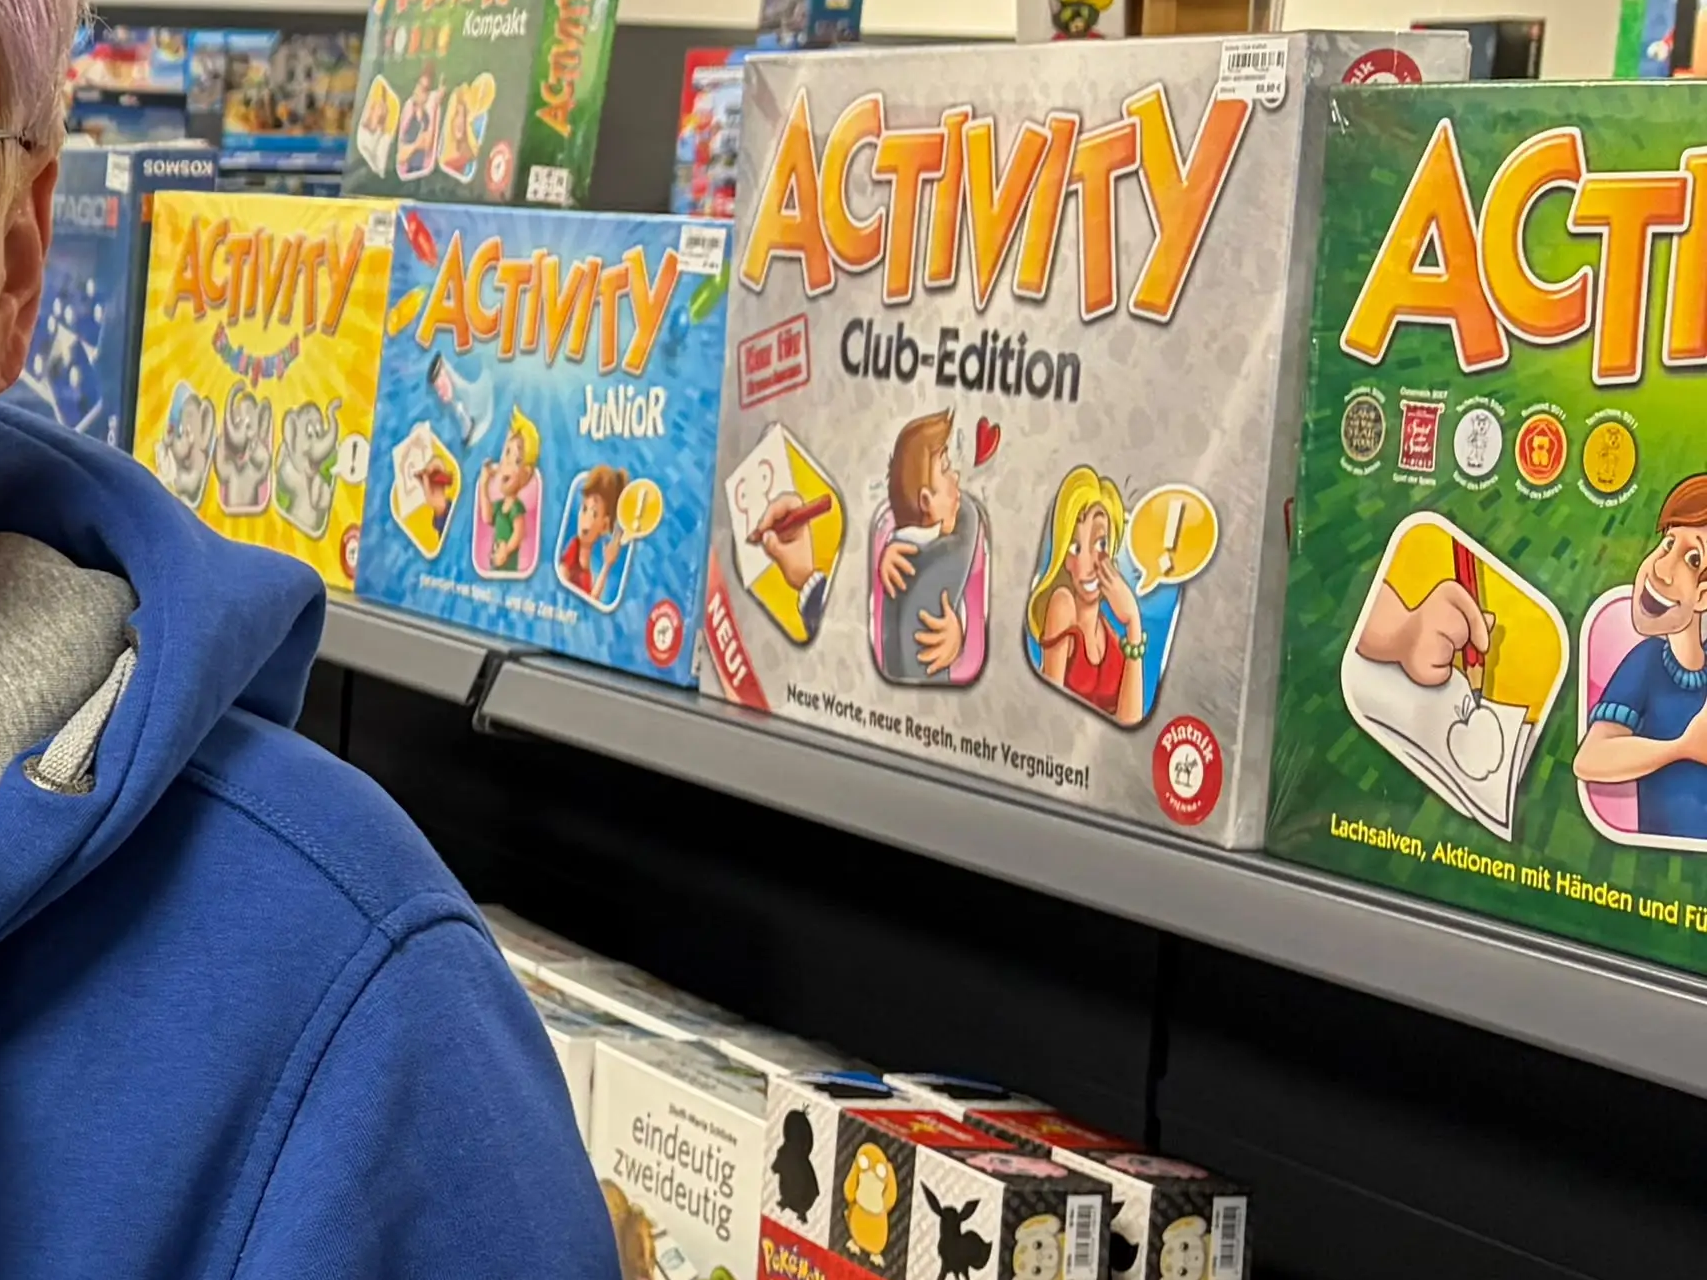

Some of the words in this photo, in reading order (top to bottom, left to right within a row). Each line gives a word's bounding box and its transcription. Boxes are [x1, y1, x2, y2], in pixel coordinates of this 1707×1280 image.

[462, 7, 528, 41] Kompakt
[142, 157, 214, 179] KOSMOS
[739, 83, 1252, 326] ACTIVITY
[163, 213, 366, 337] ACTIVITY
[416, 229, 680, 375] ACTIVITY
[839, 316, 1082, 403] Club-Edition
[707, 590, 748, 687] NEU!
[787, 683, 820, 711] Neue
[821, 693, 868, 724] Worte,
[869, 709, 902, 735] neue
[905, 716, 958, 753] Regeln,
[960, 735, 998, 763] mehr
[1000, 744, 1090, 790] Vergnügen!
[1161, 723, 1214, 765] Piatnik
[1330, 812, 1427, 863] Lachsalven,
[1431, 840, 1516, 882] Aktionen
[1520, 864, 1551, 892] mit
[1555, 870, 1633, 913] Händen
[1638, 896, 1680, 929] und
[612, 1147, 733, 1243] zweideutig
[631, 1111, 736, 1199] eindeutig
